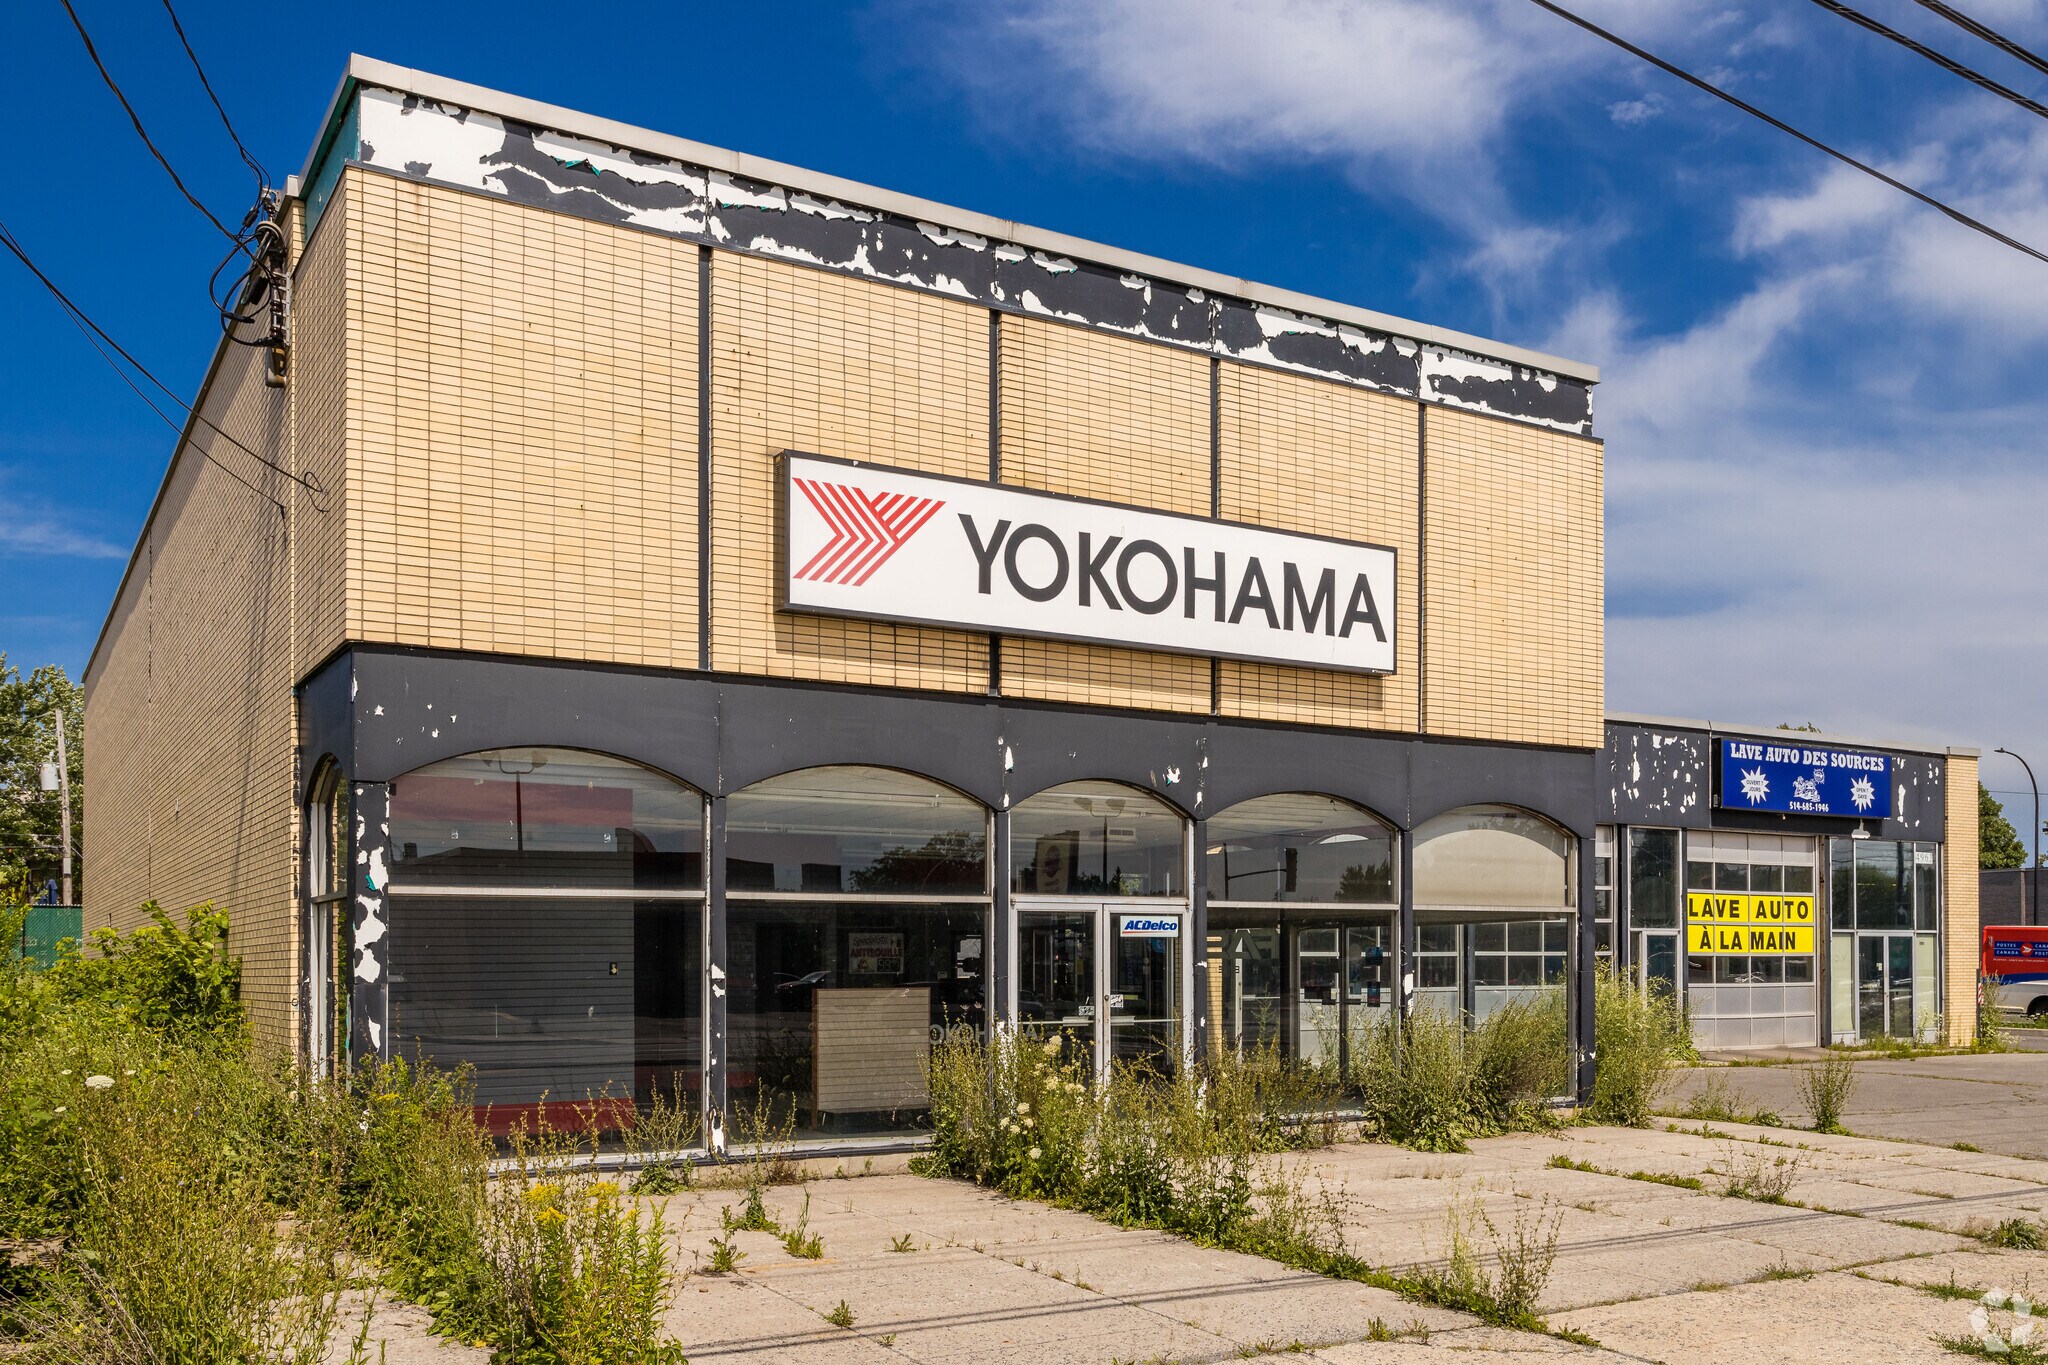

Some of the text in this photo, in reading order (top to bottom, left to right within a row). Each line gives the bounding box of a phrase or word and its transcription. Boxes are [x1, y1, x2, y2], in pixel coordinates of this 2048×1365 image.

[957, 513, 1388, 643] YOKOHAMA
[1730, 743, 1885, 772] LAVE AUTO DES SOURCES
[1689, 898, 1809, 919] LAVE AUTO
[1124, 920, 1178, 931] ACDelco
[1699, 925, 1796, 950] À LA MAIN
